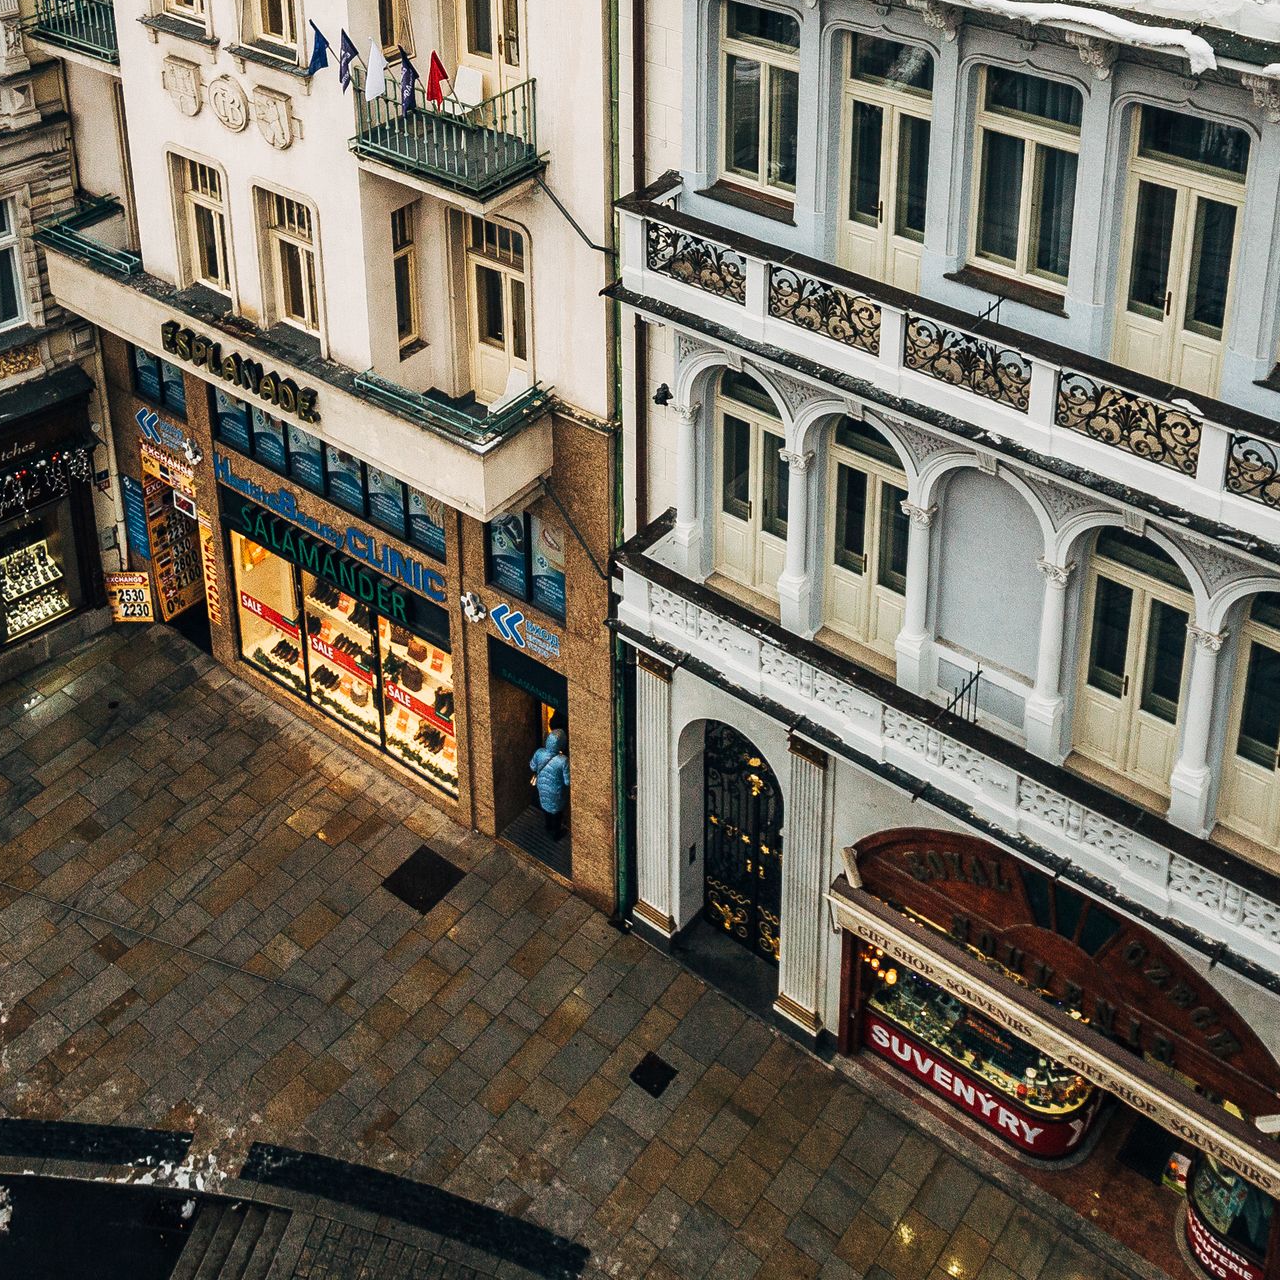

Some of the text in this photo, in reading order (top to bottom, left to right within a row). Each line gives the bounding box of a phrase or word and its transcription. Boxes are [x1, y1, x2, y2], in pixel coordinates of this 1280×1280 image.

[161, 320, 319, 424] ESPLANADE
[141, 443, 194, 478] EXCHANGE
[173, 550, 198, 575] 2800
[241, 506, 408, 624] SALAMANDER
[346, 526, 446, 602] CLINIC
[118, 589, 144, 603] 2530
[122, 603, 150, 617] 2230
[242, 596, 263, 615] SALE
[312, 638, 334, 660] SALE
[388, 684, 411, 707] SALE
[502, 669, 559, 706] SALAMANDER
[904, 851, 1013, 892] ROYAL
[858, 926, 891, 950] GIFT
[893, 946, 934, 976] SHOP
[946, 978, 1033, 1037] SOUVENIRS
[871, 1024, 1044, 1145] SUVENÝRY
[1067, 1055, 1107, 1082] GIFT
[1109, 1080, 1158, 1114] SHOP
[1170, 1118, 1272, 1189] SOUVENIRS
[1194, 1242, 1227, 1279] TOYS
